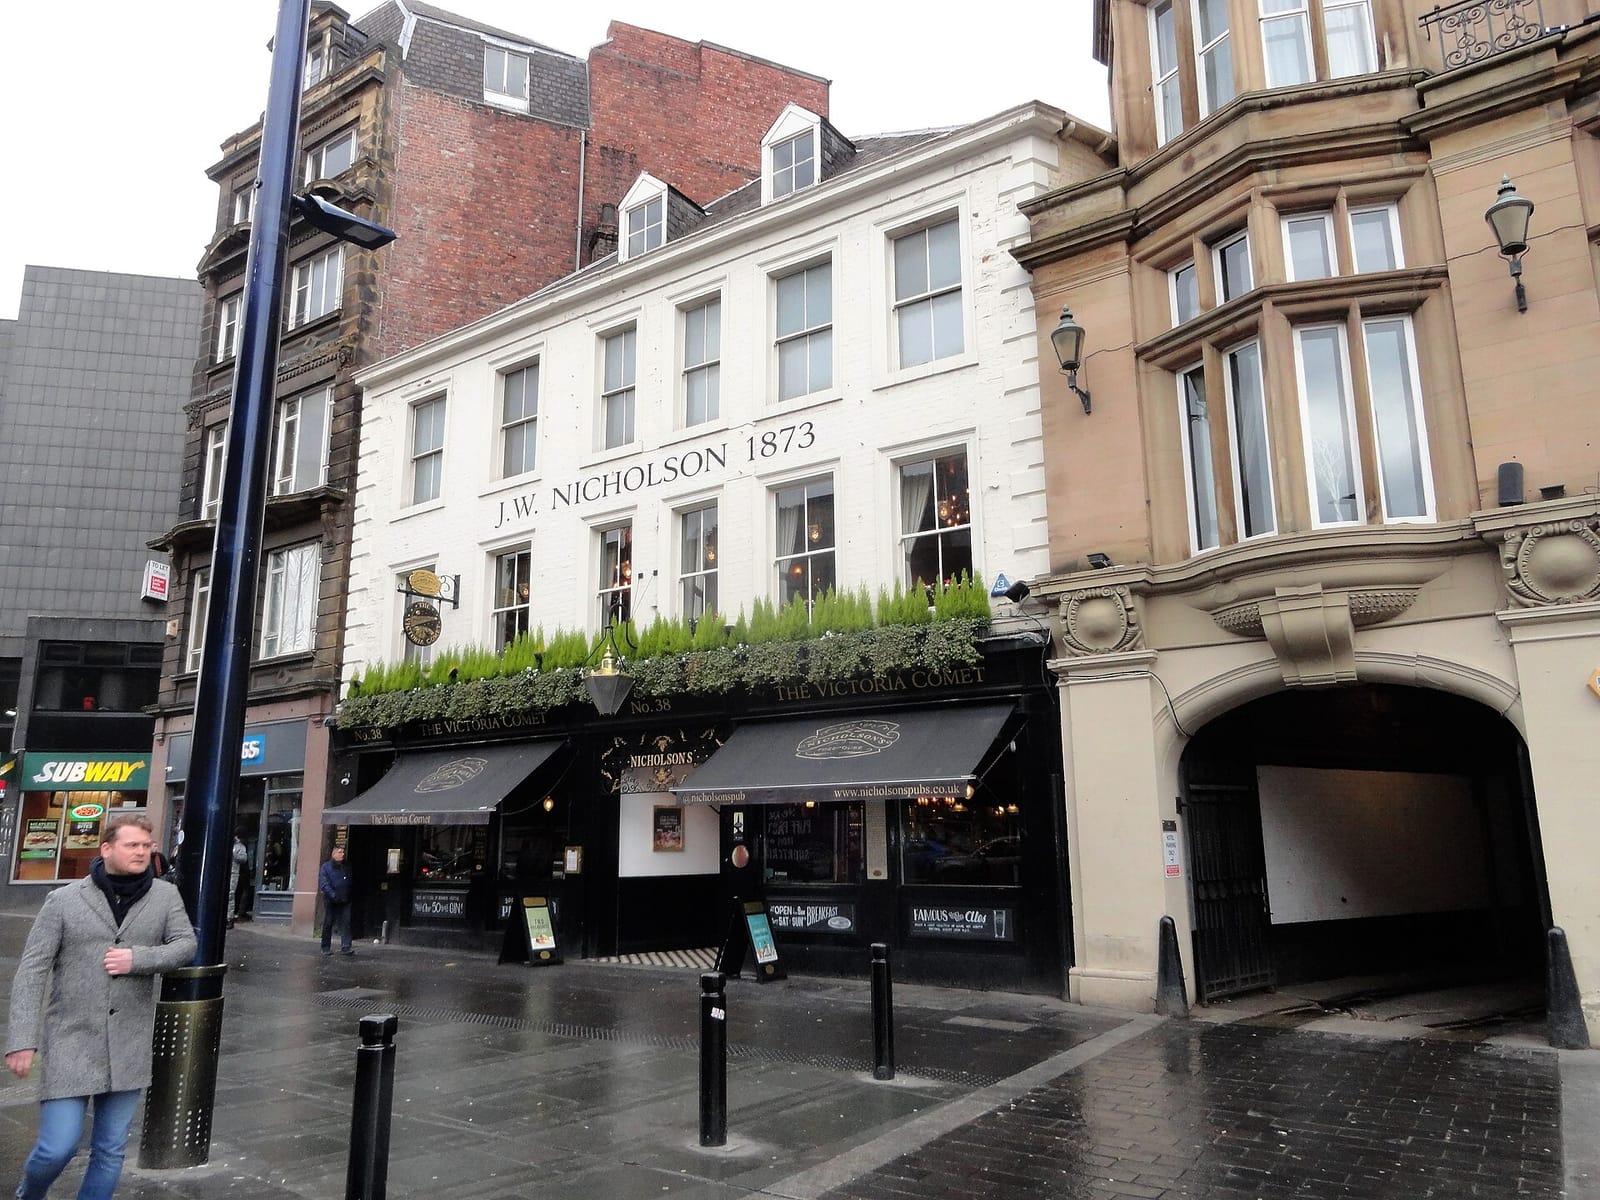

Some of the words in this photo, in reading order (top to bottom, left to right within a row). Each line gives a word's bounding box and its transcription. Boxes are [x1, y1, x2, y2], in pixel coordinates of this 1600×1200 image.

[494, 494, 538, 528] J.W.
[552, 443, 728, 510] NICHOLSON
[746, 421, 816, 462] 1873
[774, 685, 811, 702] THE
[814, 675, 907, 697] VICTORIA
[911, 667, 985, 689] COMET
[630, 700, 653, 714] No.
[655, 698, 671, 712] 38
[420, 723, 443, 737] THE
[444, 716, 500, 733] VICTORIA
[503, 711, 547, 727] COMET
[370, 728, 383, 740] 38
[32, 760, 145, 783] SUBWAY
[834, 783, 960, 798] www.nicholsonspubs.co.uk
[74, 807, 99, 817] OPEN
[371, 814, 382, 824] The
[383, 814, 408, 825] Victoria
[409, 813, 431, 824] Comet
[774, 905, 793, 915] OPEN
[806, 906, 839, 927] BREAKFAST
[778, 916, 789, 927] SAT
[791, 917, 804, 928] SUN
[913, 908, 948, 922] FAMOUS
